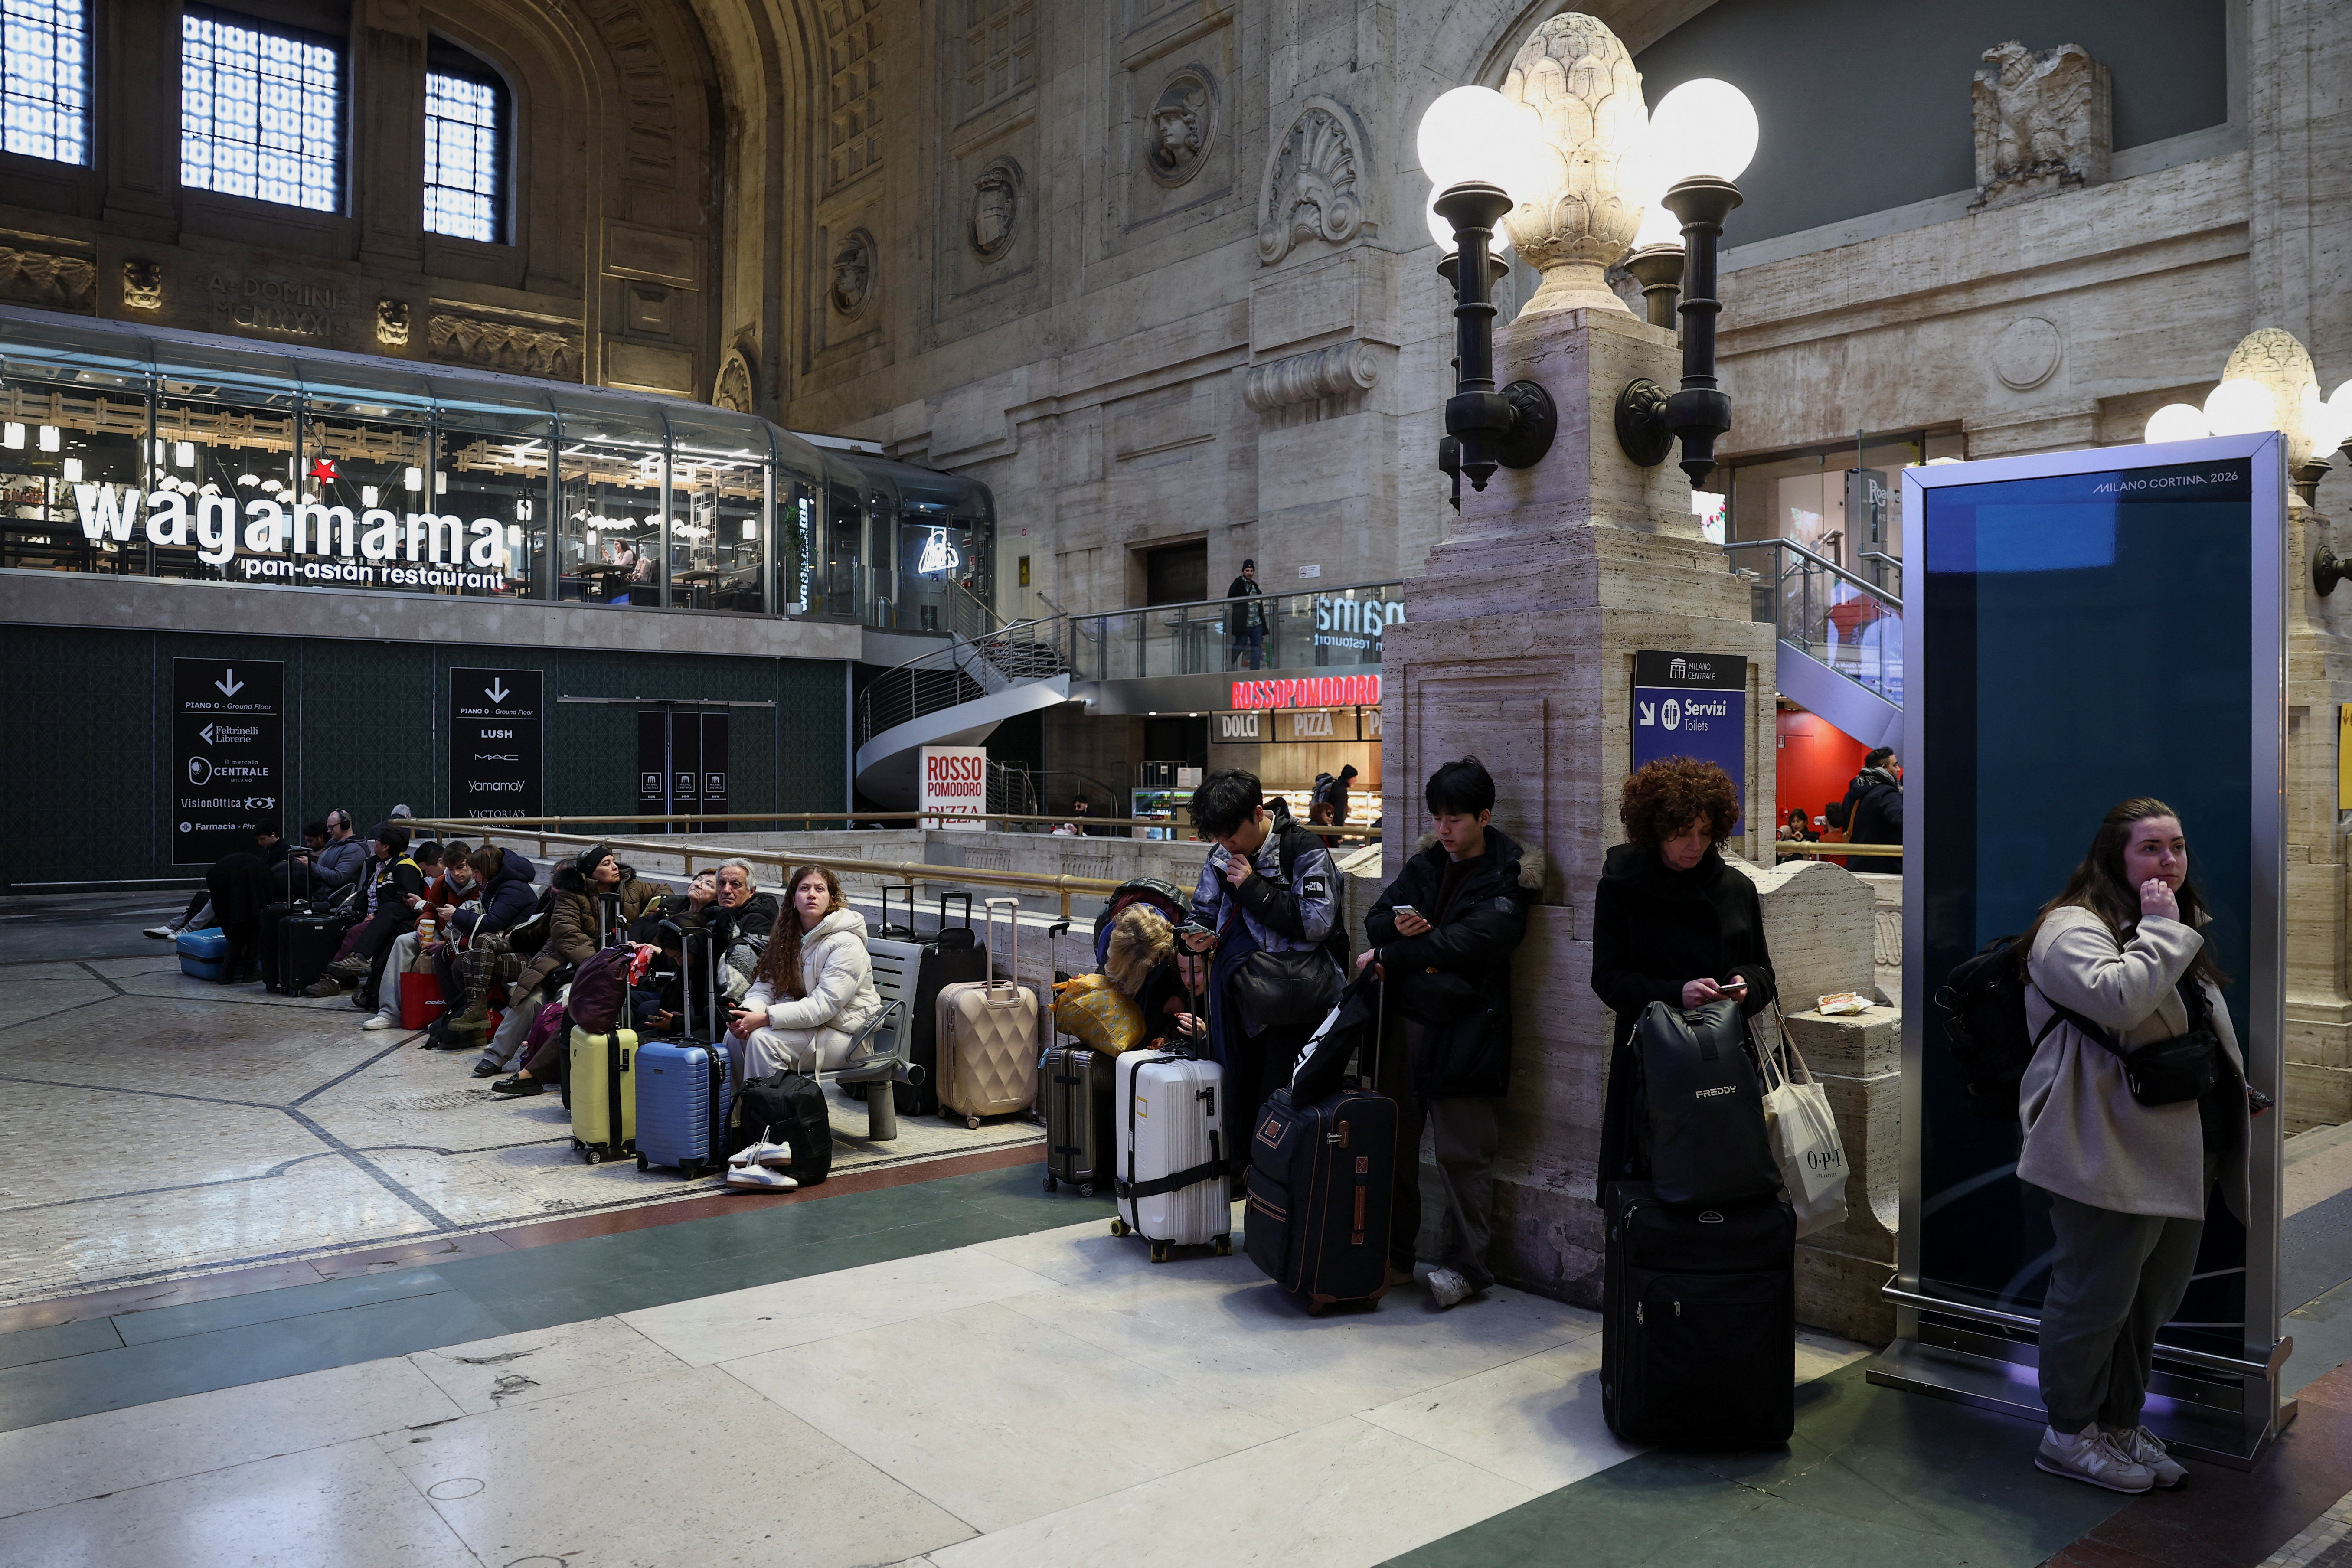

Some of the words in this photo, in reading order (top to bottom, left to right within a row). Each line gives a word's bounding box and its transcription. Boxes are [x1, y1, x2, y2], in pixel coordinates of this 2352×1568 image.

[2092, 480, 2147, 493] MILANO
[2149, 475, 2207, 488] CORTINA
[2210, 471, 2238, 483] 2026
[74, 483, 504, 568] wagamama
[244, 558, 374, 582] pan-asian
[381, 567, 504, 589] restaurant
[1689, 662, 1711, 671] MILANO
[1688, 672, 1715, 680] CENTRALE
[1232, 674, 1382, 710] ROSSOPOMODORO
[1684, 699, 1727, 716] Servizi
[215, 725, 258, 735] Feltrinelli
[1222, 715, 1259, 737] DOLCI
[1294, 712, 1334, 736] PIZZA
[1684, 718, 1708, 731] Toilets
[215, 735, 251, 743] Librerie
[481, 729, 513, 738] LUSH
[214, 767, 269, 776] CENTRALE
[928, 756, 982, 781] ROSSO
[468, 780, 525, 793] yamamay
[928, 782, 982, 797] POMODORO
[181, 798, 241, 808] VisionOttica
[928, 805, 981, 824] PIZZA
[195, 822, 235, 830] Farmacia
[1695, 1085, 1736, 1099] FREDDY
